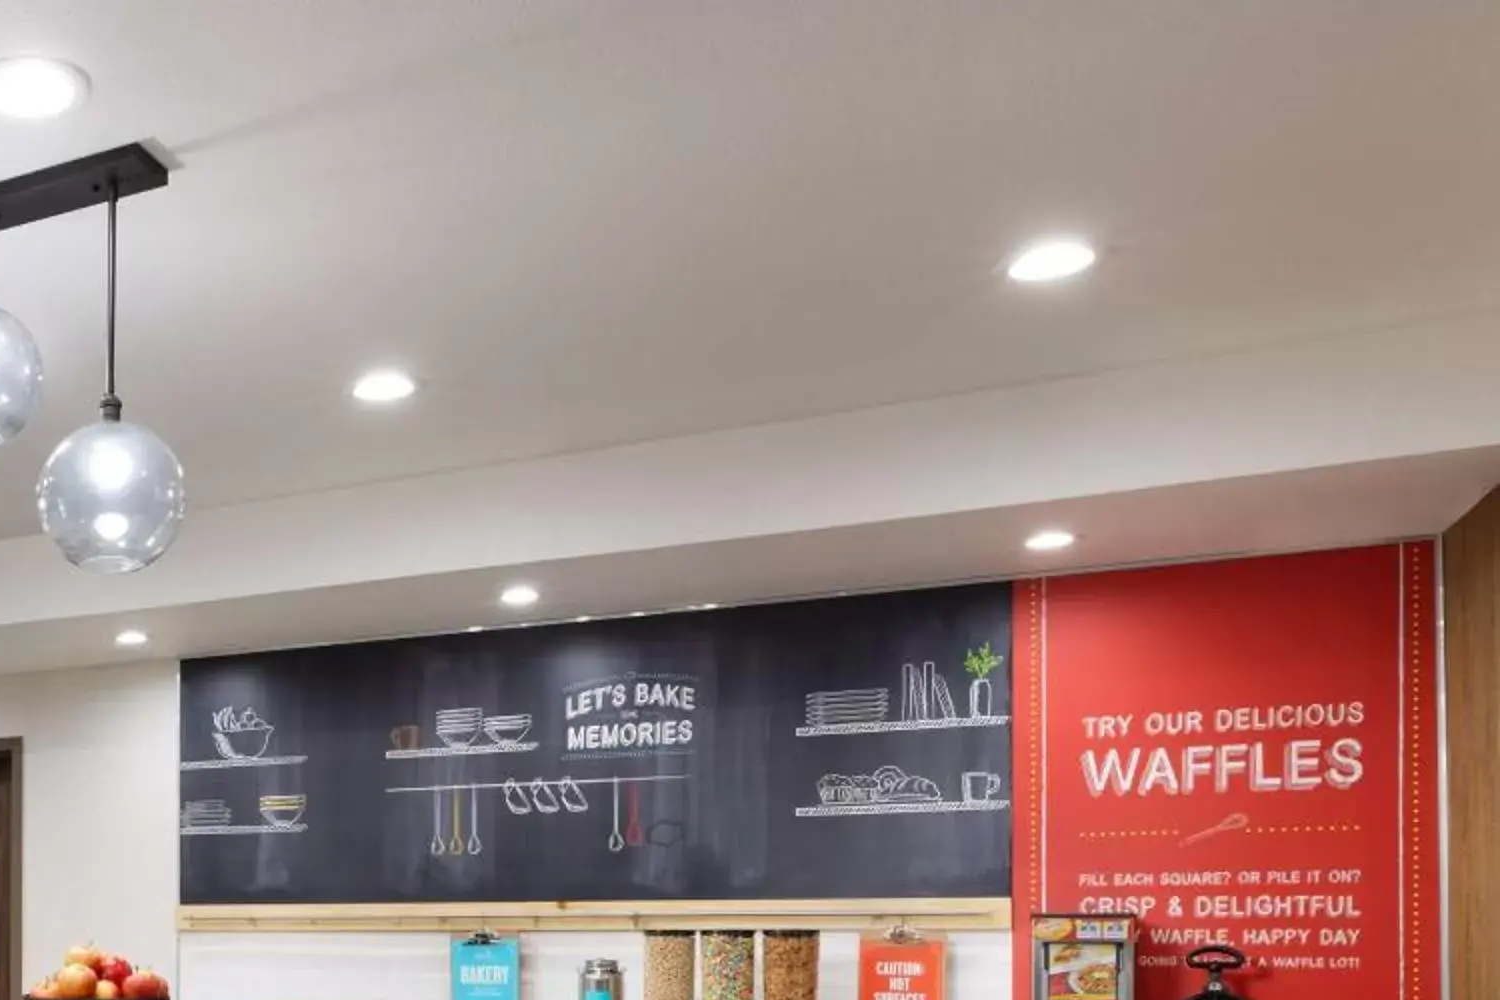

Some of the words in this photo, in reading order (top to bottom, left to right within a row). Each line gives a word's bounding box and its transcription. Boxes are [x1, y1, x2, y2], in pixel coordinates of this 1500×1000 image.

[565, 683, 626, 720] LET'S
[634, 682, 695, 711] BAKE
[1081, 714, 1134, 739] TRY
[1144, 710, 1204, 737] OUR
[1214, 701, 1365, 732] DELICIOUS
[566, 719, 693, 750] MEMORIES
[1079, 738, 1364, 798] WAFFLES
[1078, 874, 1108, 887] FILL
[1113, 873, 1154, 887] EACH
[1159, 871, 1231, 886] SQUARE?
[1238, 871, 1261, 885] OR
[1266, 870, 1301, 884] PILE
[1307, 870, 1322, 883] IT
[1328, 869, 1361, 884] ON?
[1079, 896, 1156, 919] CRISP
[1167, 895, 1184, 918] &
[1194, 895, 1362, 918] DELIGHTFUL
[1150, 928, 1235, 946] WAFFLE,
[1243, 928, 1311, 946] HAPPY
[1319, 929, 1361, 946] DAY
[1257, 956, 1268, 968] A
[1272, 957, 1325, 969] WAFFLE
[460, 965, 509, 986] BAKERY
[888, 977, 910, 992] HOT
